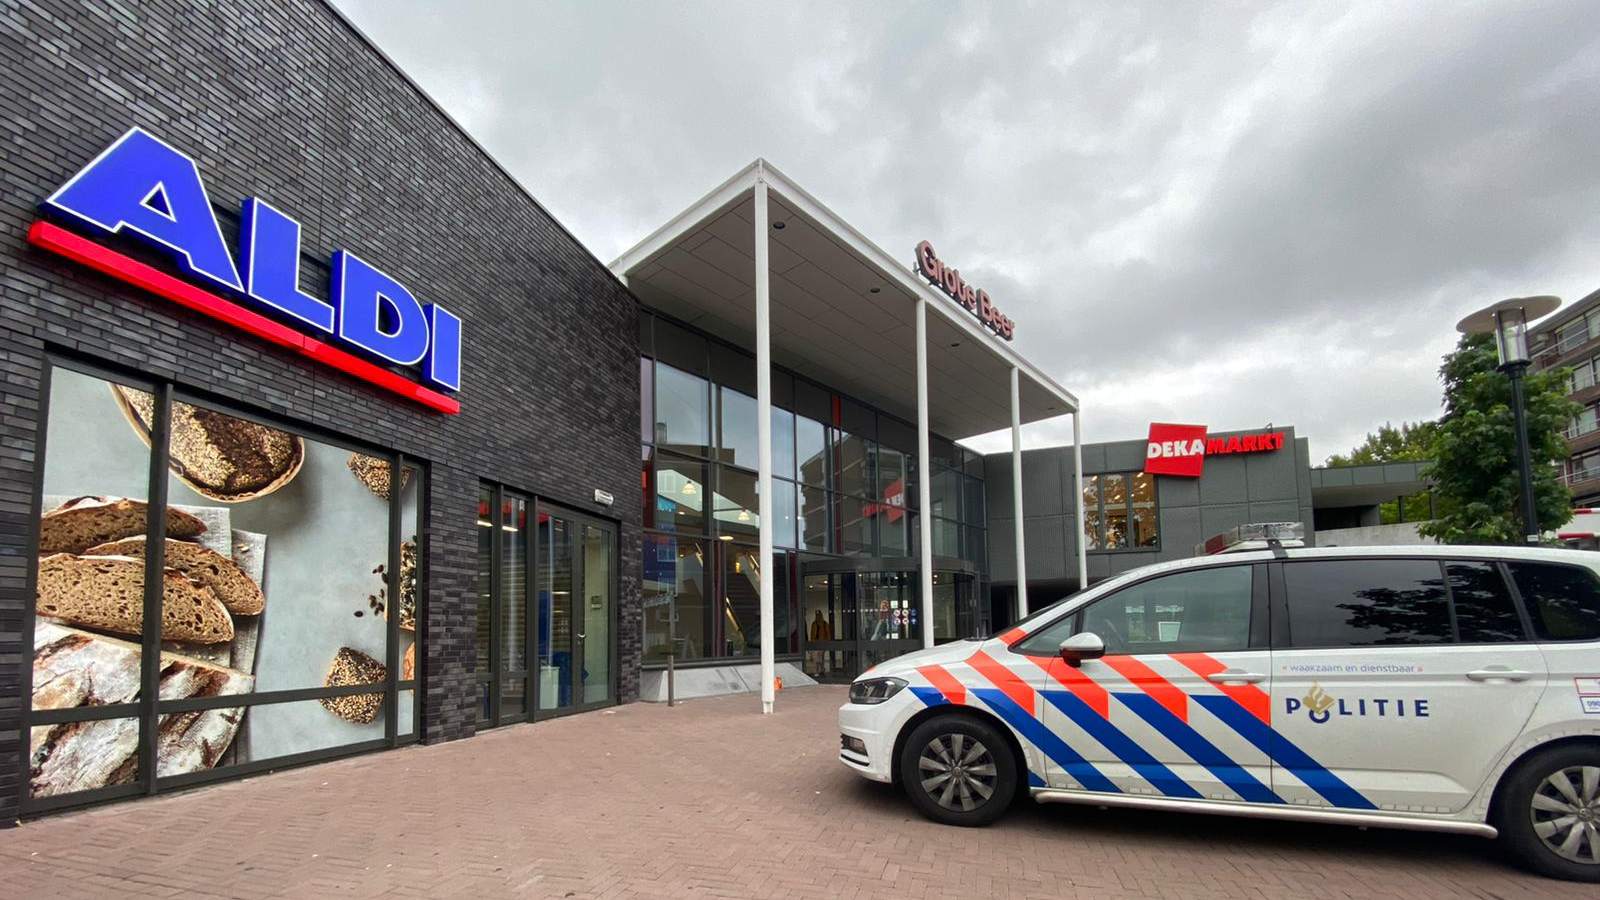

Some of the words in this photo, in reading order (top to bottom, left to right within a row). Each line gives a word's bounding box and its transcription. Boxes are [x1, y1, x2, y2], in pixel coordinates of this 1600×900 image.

[46, 126, 462, 391] ALDI
[916, 240, 977, 311] Grote
[976, 288, 1015, 339] Beer
[1289, 664, 1343, 673] waakzaam
[1345, 665, 1358, 673] en
[1361, 664, 1415, 673] dienstbaar
[1285, 697, 1430, 724] POLITIE
